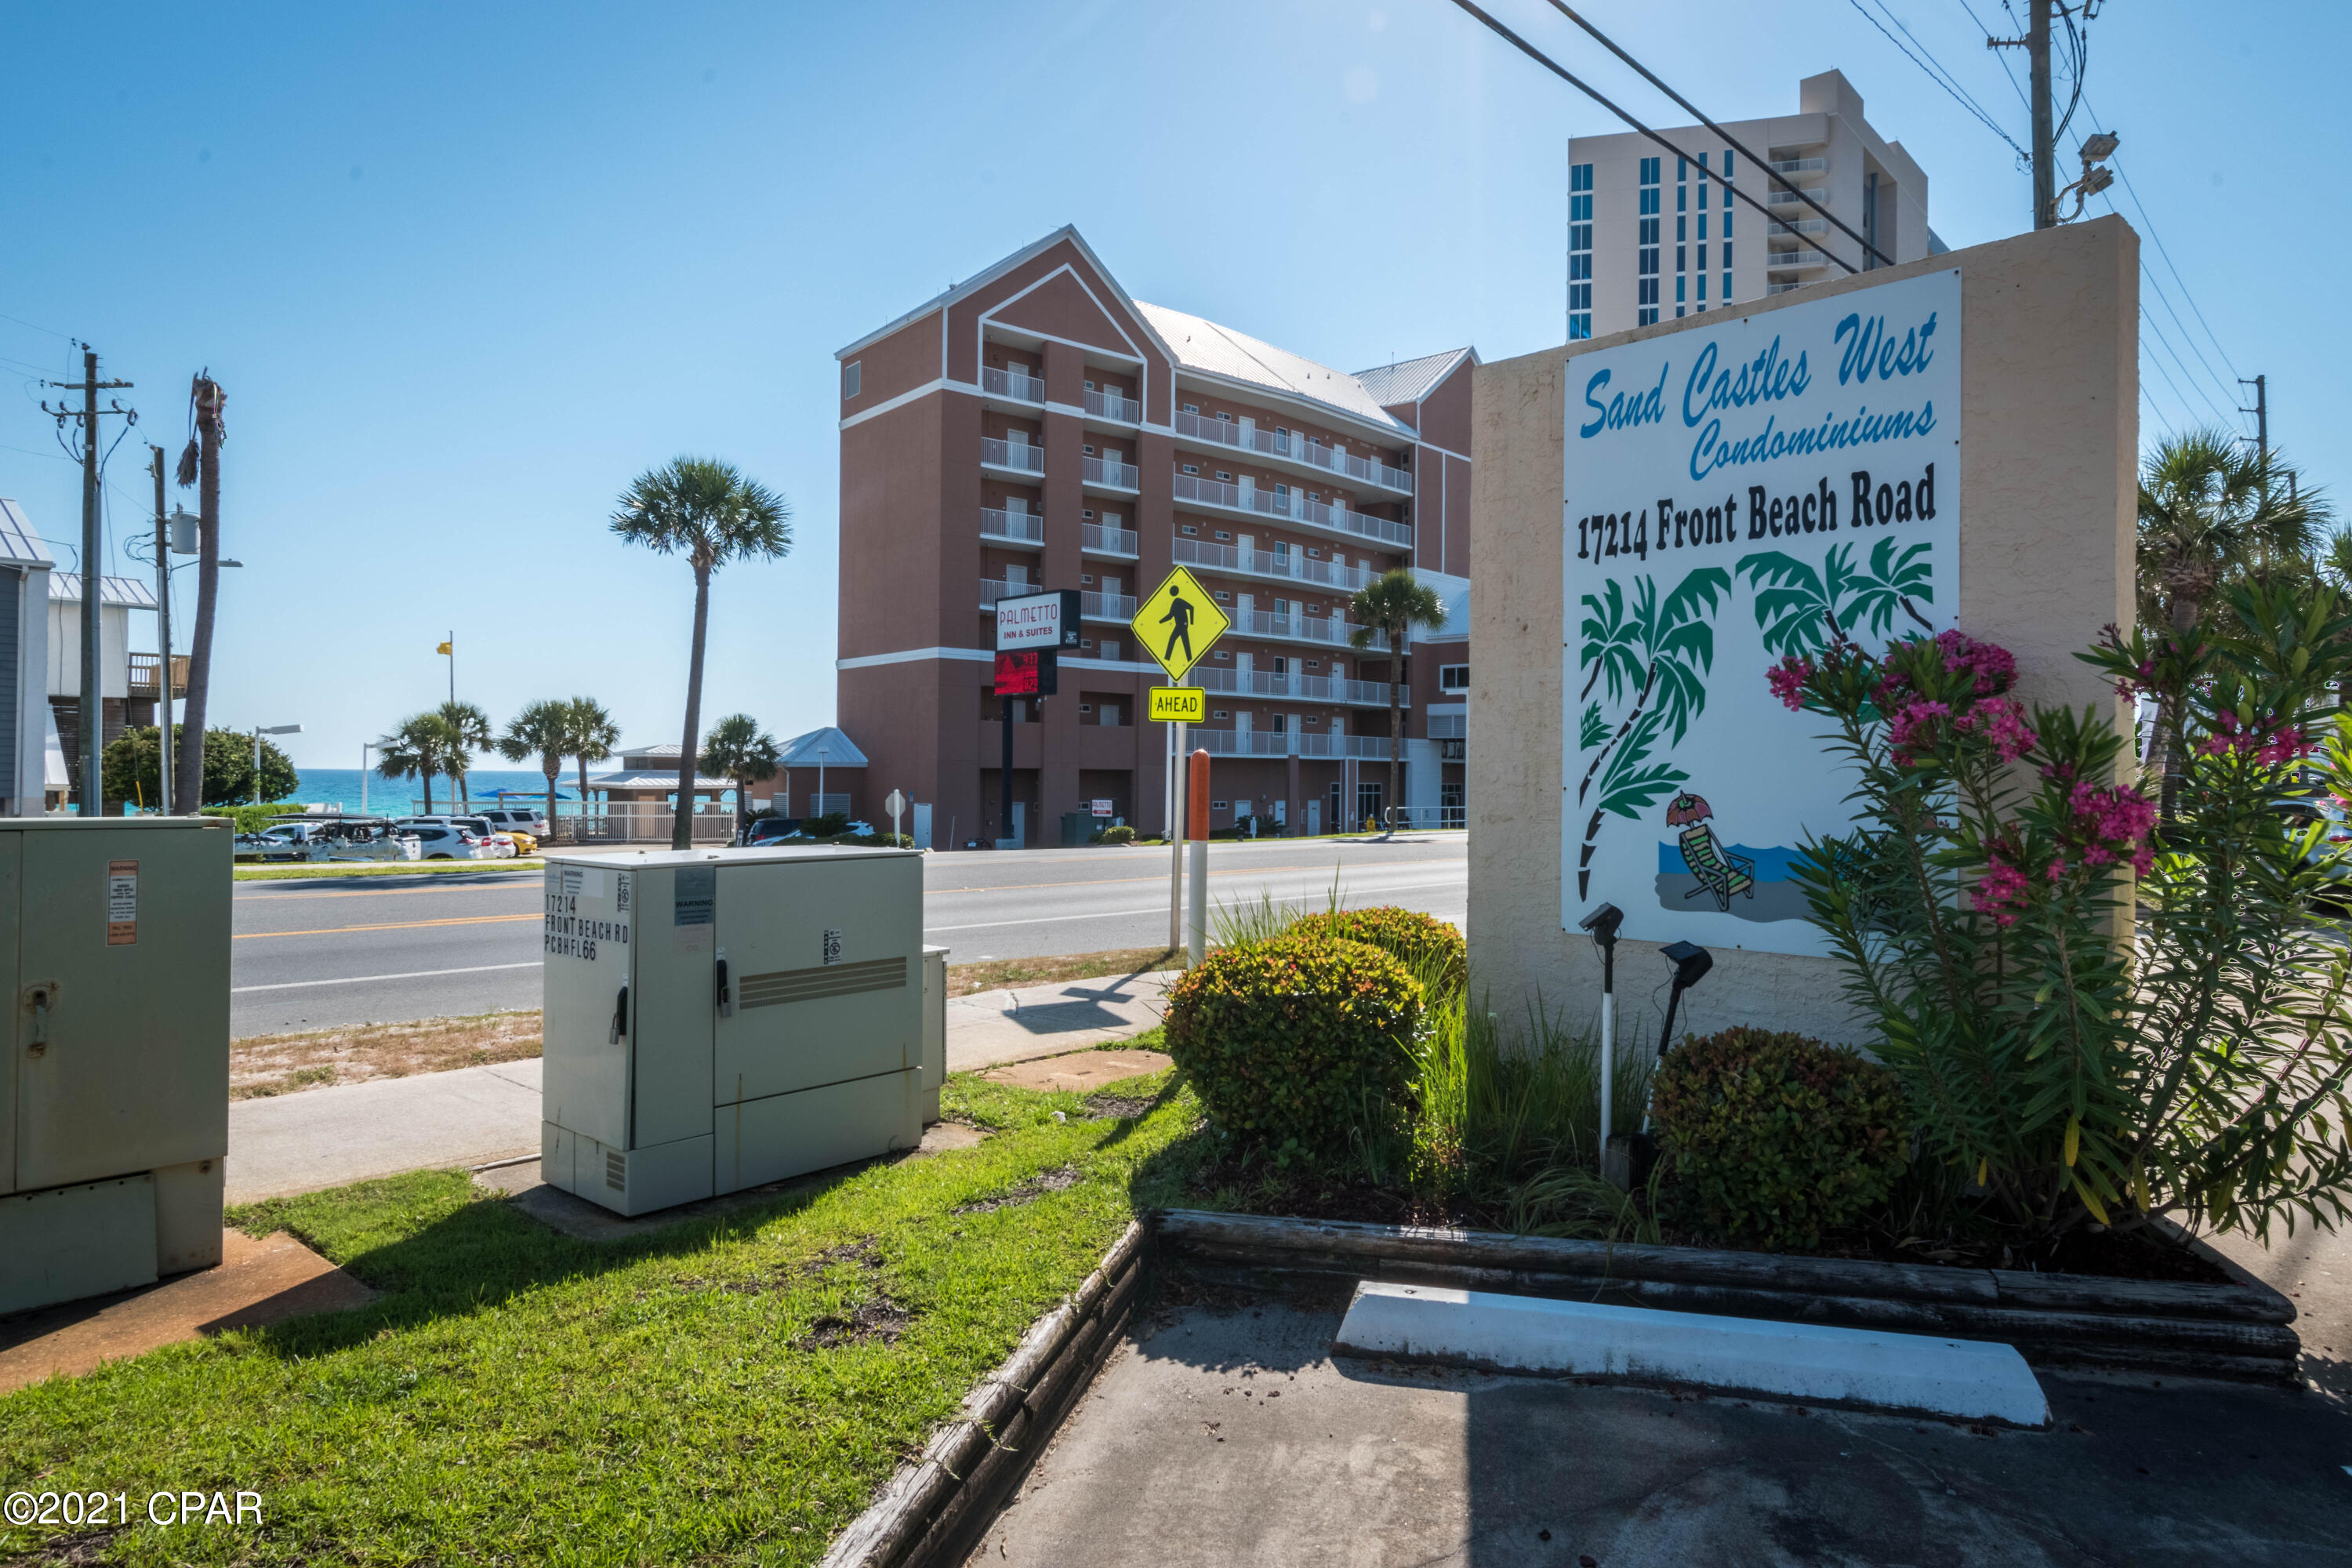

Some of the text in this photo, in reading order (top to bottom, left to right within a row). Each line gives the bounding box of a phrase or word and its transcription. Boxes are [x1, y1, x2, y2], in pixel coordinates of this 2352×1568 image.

[1580, 311, 1937, 439] Sand Castles West
[1690, 401, 1937, 481] Condominiums
[1577, 462, 1936, 565] 17214 Front Beach Road
[1000, 604, 1058, 626] PALMETTO
[1004, 630, 1016, 639] INN
[1025, 626, 1053, 637] SUITES
[1156, 696, 1198, 712] AHEAD
[546, 894, 575, 914] 17214
[676, 899, 713, 908] WARNING
[546, 914, 628, 944] FRONT BEACH RD
[546, 934, 596, 961] PCBHFL66
